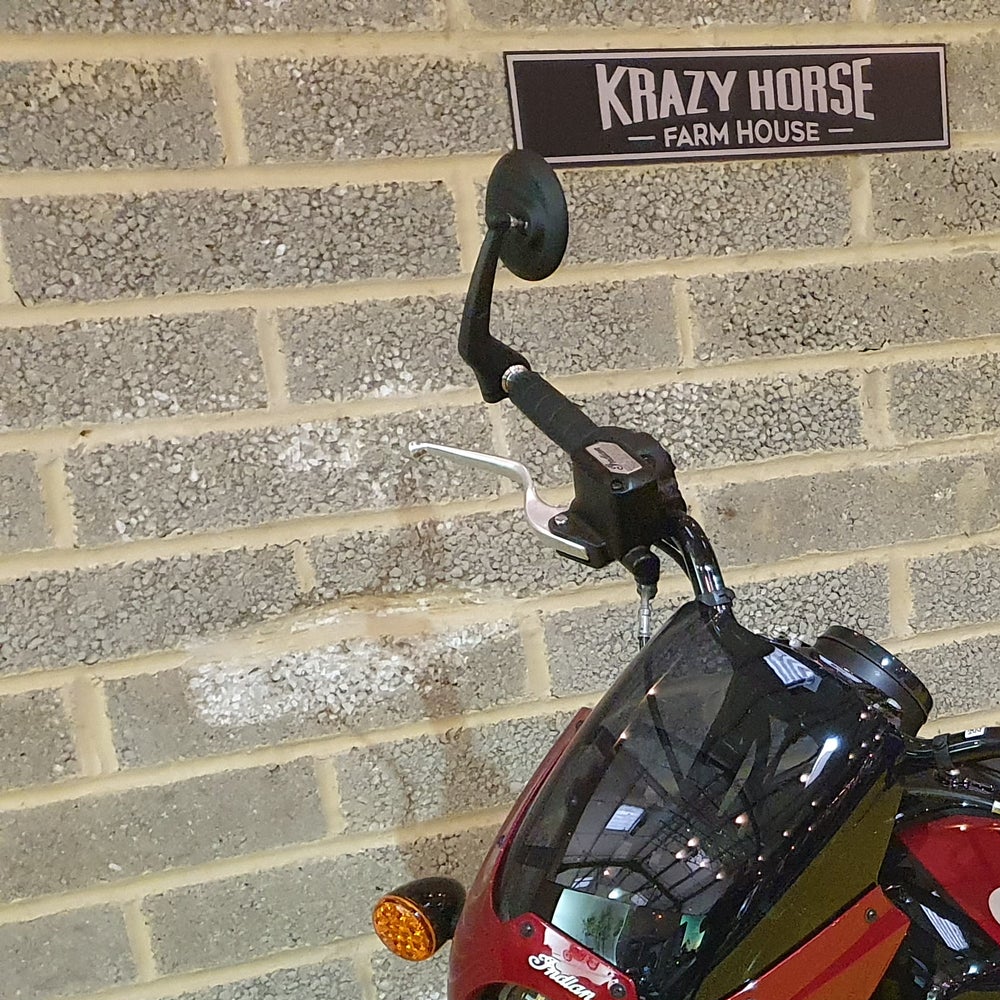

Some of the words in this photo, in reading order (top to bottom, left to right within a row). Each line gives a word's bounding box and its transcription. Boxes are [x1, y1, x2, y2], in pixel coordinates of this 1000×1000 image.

[595, 63, 738, 130] KRAZY
[749, 57, 875, 120] HORSE
[663, 122, 729, 148] FARM
[737, 119, 820, 145] HOUSE
